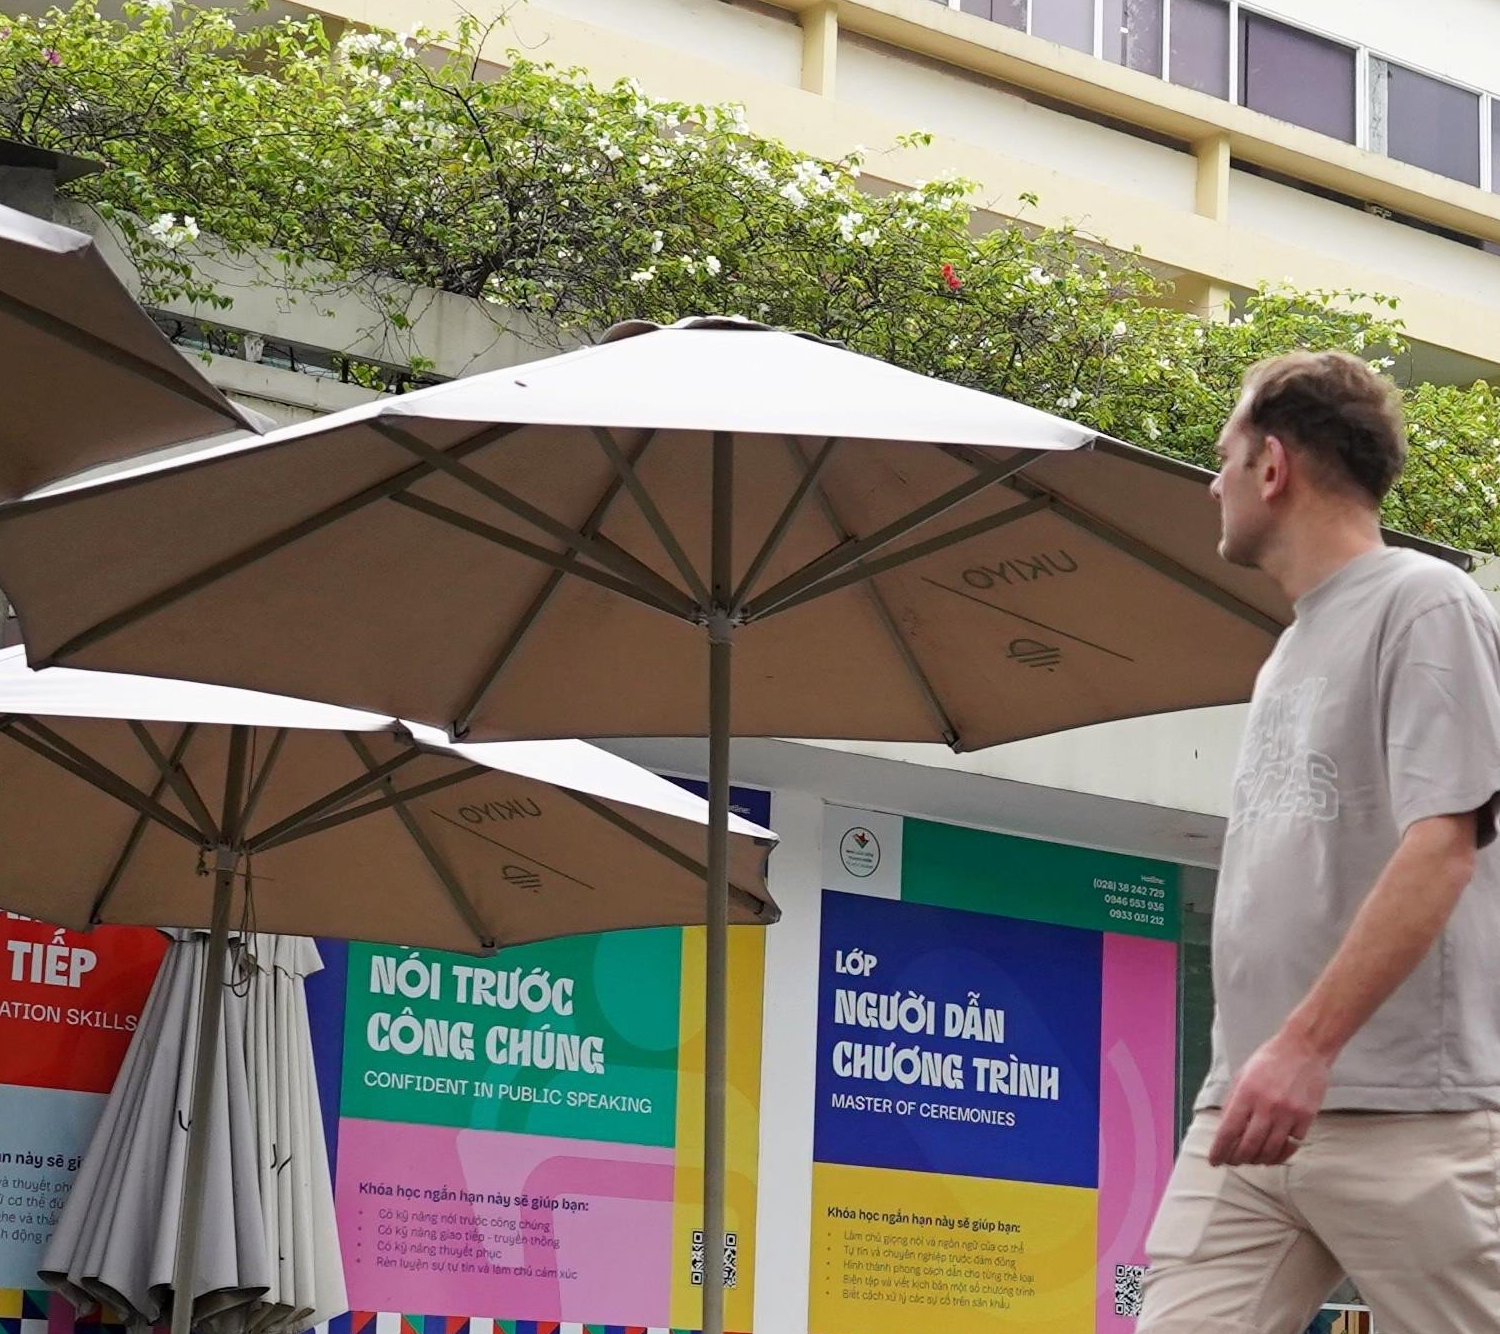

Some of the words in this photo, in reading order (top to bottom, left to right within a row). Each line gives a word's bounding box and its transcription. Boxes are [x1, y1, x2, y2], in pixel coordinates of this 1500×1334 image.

[1093, 878, 1116, 891] (028)
[1118, 882, 1129, 893] 38
[1131, 885, 1148, 896] 242
[1109, 909, 1133, 921] 0933
[1134, 913, 1149, 923] 031
[1150, 915, 1165, 926] 212
[7, 927, 97, 988] TIẾP
[835, 949, 877, 977] LỚP
[370, 950, 442, 1003] NÓI
[452, 963, 574, 1017] TRƯỚC
[66, 1008, 137, 1031] SKILLS
[834, 989, 935, 1037] NGƯỜI
[944, 993, 1005, 1045] DẪN
[367, 1008, 475, 1061] CÔNG
[484, 1018, 605, 1075] CHÚNG
[832, 1041, 964, 1091] CHƯƠNG
[973, 1051, 1060, 1101] TRÌNH
[363, 1071, 468, 1098] CONFIDENT
[473, 1081, 493, 1100] IN
[498, 1083, 561, 1106] PUBLIC
[566, 1091, 652, 1115] SPEAKING
[831, 1093, 893, 1116] MASTER
[896, 1100, 916, 1118] OF
[919, 1102, 1016, 1128] CEREMONIES
[16, 1151, 42, 1168] này
[47, 1155, 63, 1167] sẽ
[359, 1183, 393, 1196] Khóa
[396, 1185, 421, 1200] học
[424, 1188, 456, 1202] ngắn
[460, 1190, 484, 1205] hạn
[487, 1192, 510, 1207] này
[514, 1195, 528, 1206] sẽ
[532, 1196, 559, 1211] giúp
[562, 1199, 589, 1213] bạn:
[827, 1207, 855, 1219] Khóa
[859, 1209, 879, 1223] học
[882, 1212, 909, 1225] ngắn
[912, 1213, 932, 1225] hạn
[935, 1215, 954, 1229] này
[958, 1218, 969, 1228] sẽ
[972, 1219, 995, 1232] giúp
[998, 1221, 1020, 1235] bạn:
